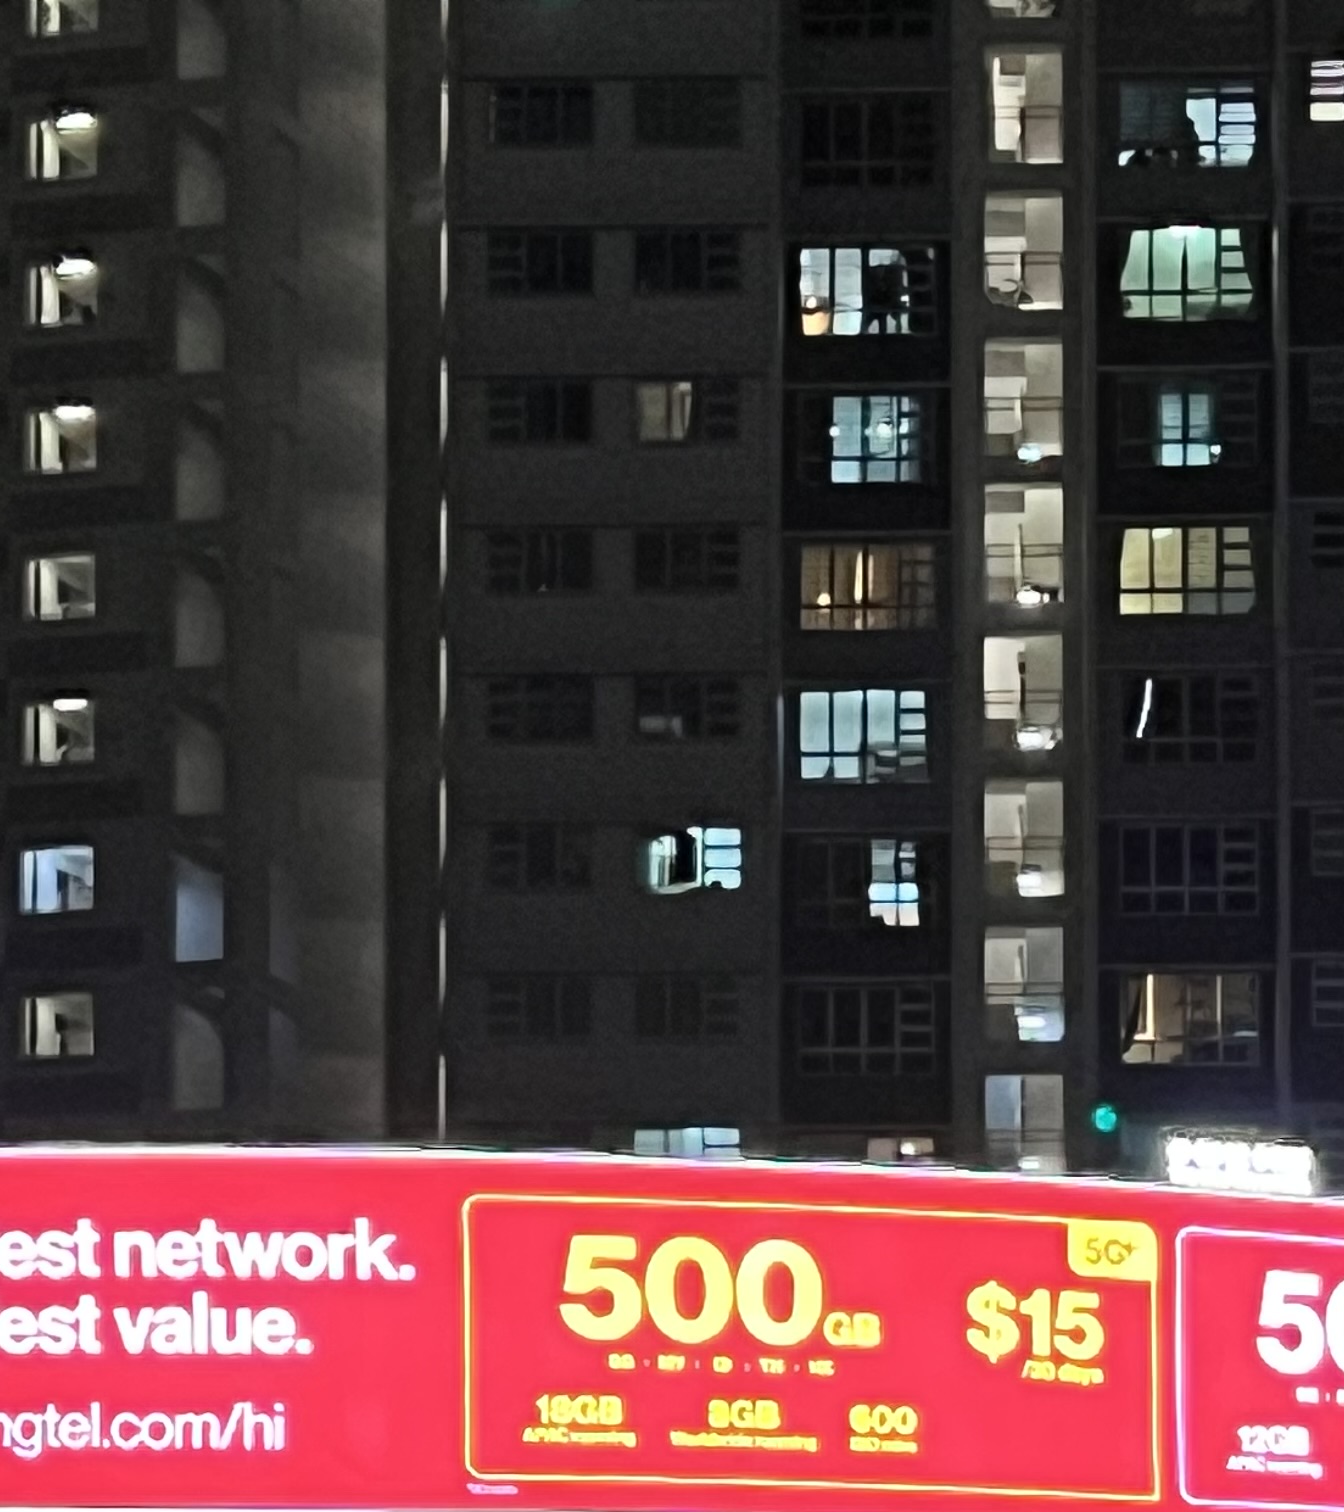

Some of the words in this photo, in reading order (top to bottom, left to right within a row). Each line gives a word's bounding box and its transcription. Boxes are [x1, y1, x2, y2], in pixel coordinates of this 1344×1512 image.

[114, 1217, 415, 1281] network.
[113, 1291, 314, 1355] value.
[967, 1280, 1104, 1363] $15
